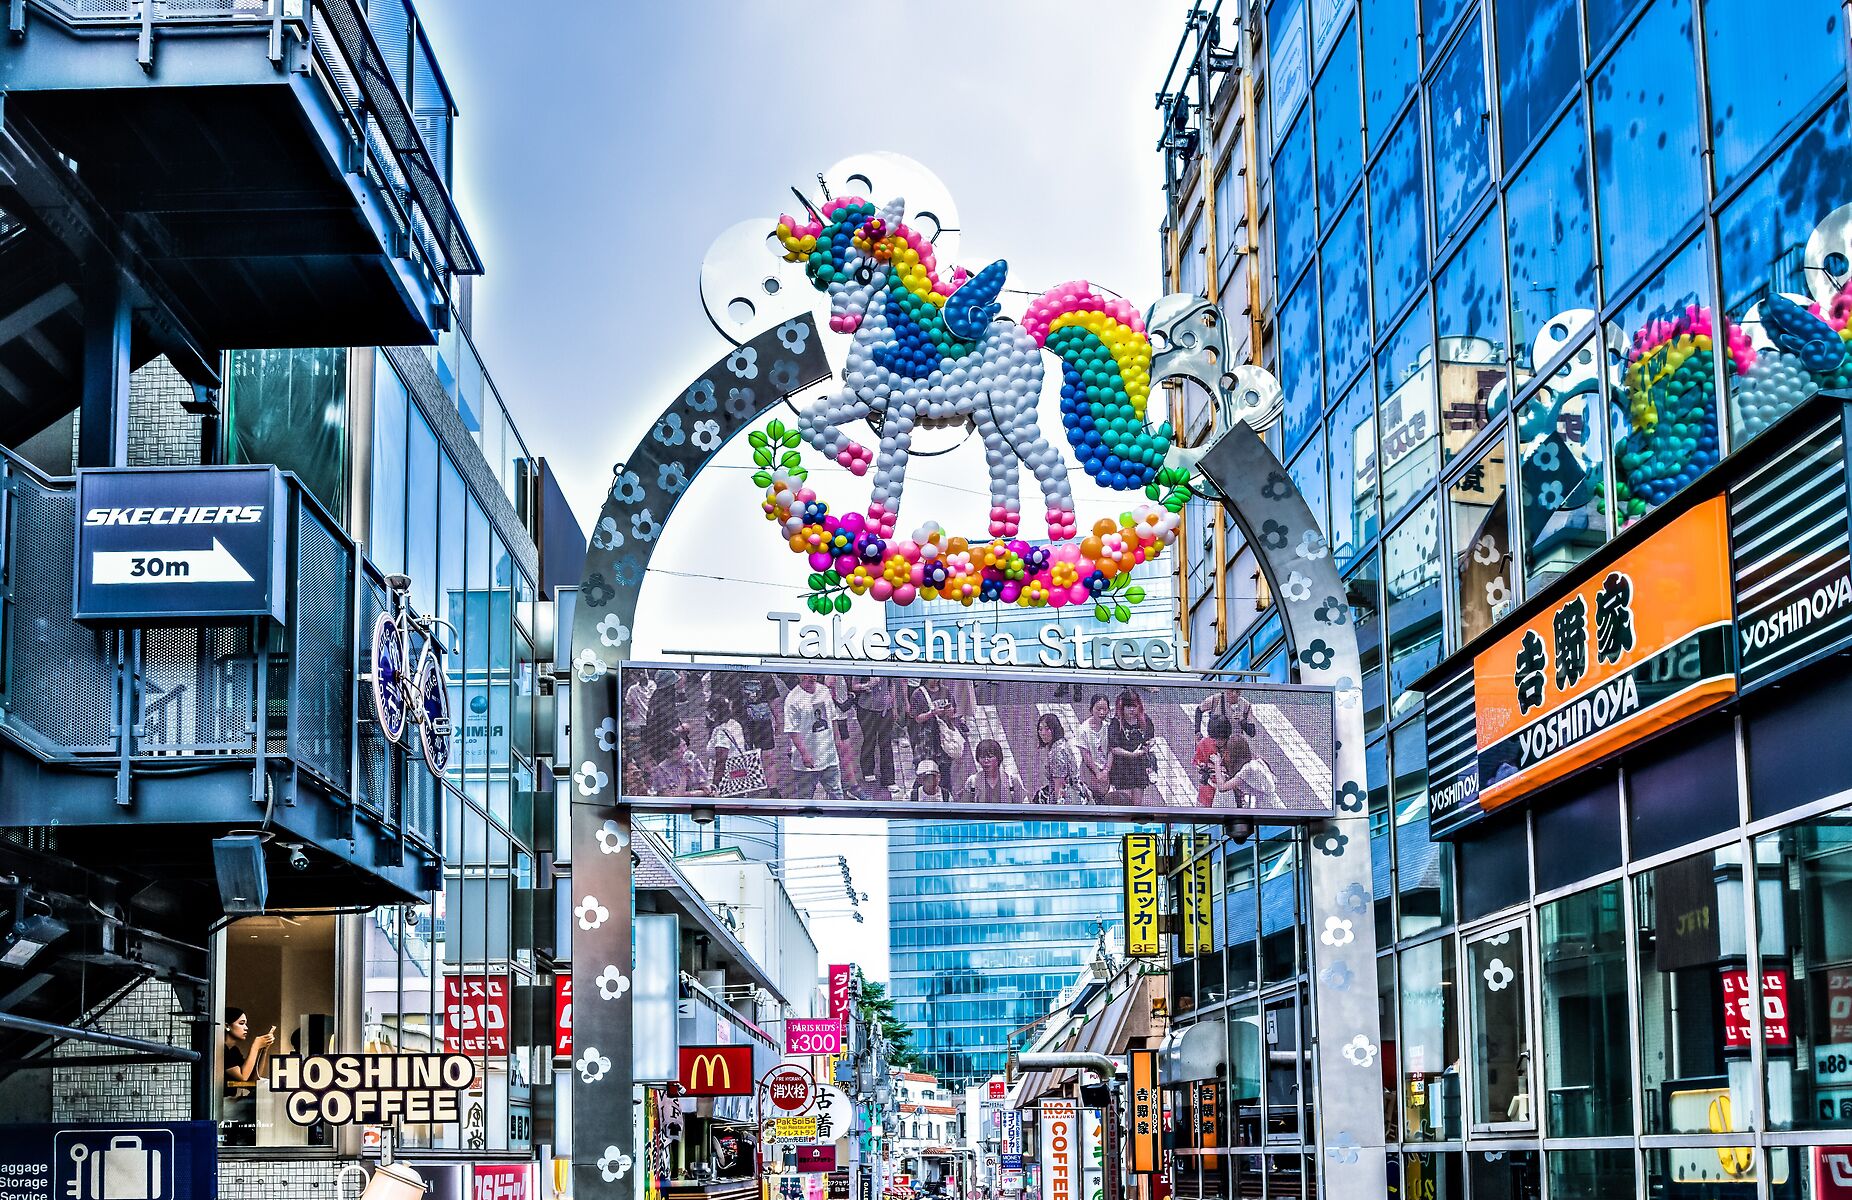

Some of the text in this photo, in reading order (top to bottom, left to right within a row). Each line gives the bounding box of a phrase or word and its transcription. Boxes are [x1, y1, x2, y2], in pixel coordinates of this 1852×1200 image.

[84, 506, 264, 526] SKECHERS
[130, 557, 189, 577] 30m
[1741, 575, 1852, 657] YOSHINOYA
[766, 611, 1194, 673] Takeshita Street
[1518, 672, 1639, 765] YOSHINOYA
[1131, 836, 1155, 941] コインロッカー
[1131, 943, 1156, 953] 3F
[792, 1023, 836, 1032] PARIS KID'S
[791, 1034, 835, 1052] ¥300
[272, 1055, 473, 1089] HOSHINO
[773, 1084, 806, 1099] 消火栓
[288, 1090, 457, 1124] COFFEE
[816, 1088, 835, 1139] 古着
[1043, 1102, 1075, 1115] NOA
[1136, 1087, 1149, 1135] 吉野家
[0, 1177, 48, 1189] Storage
